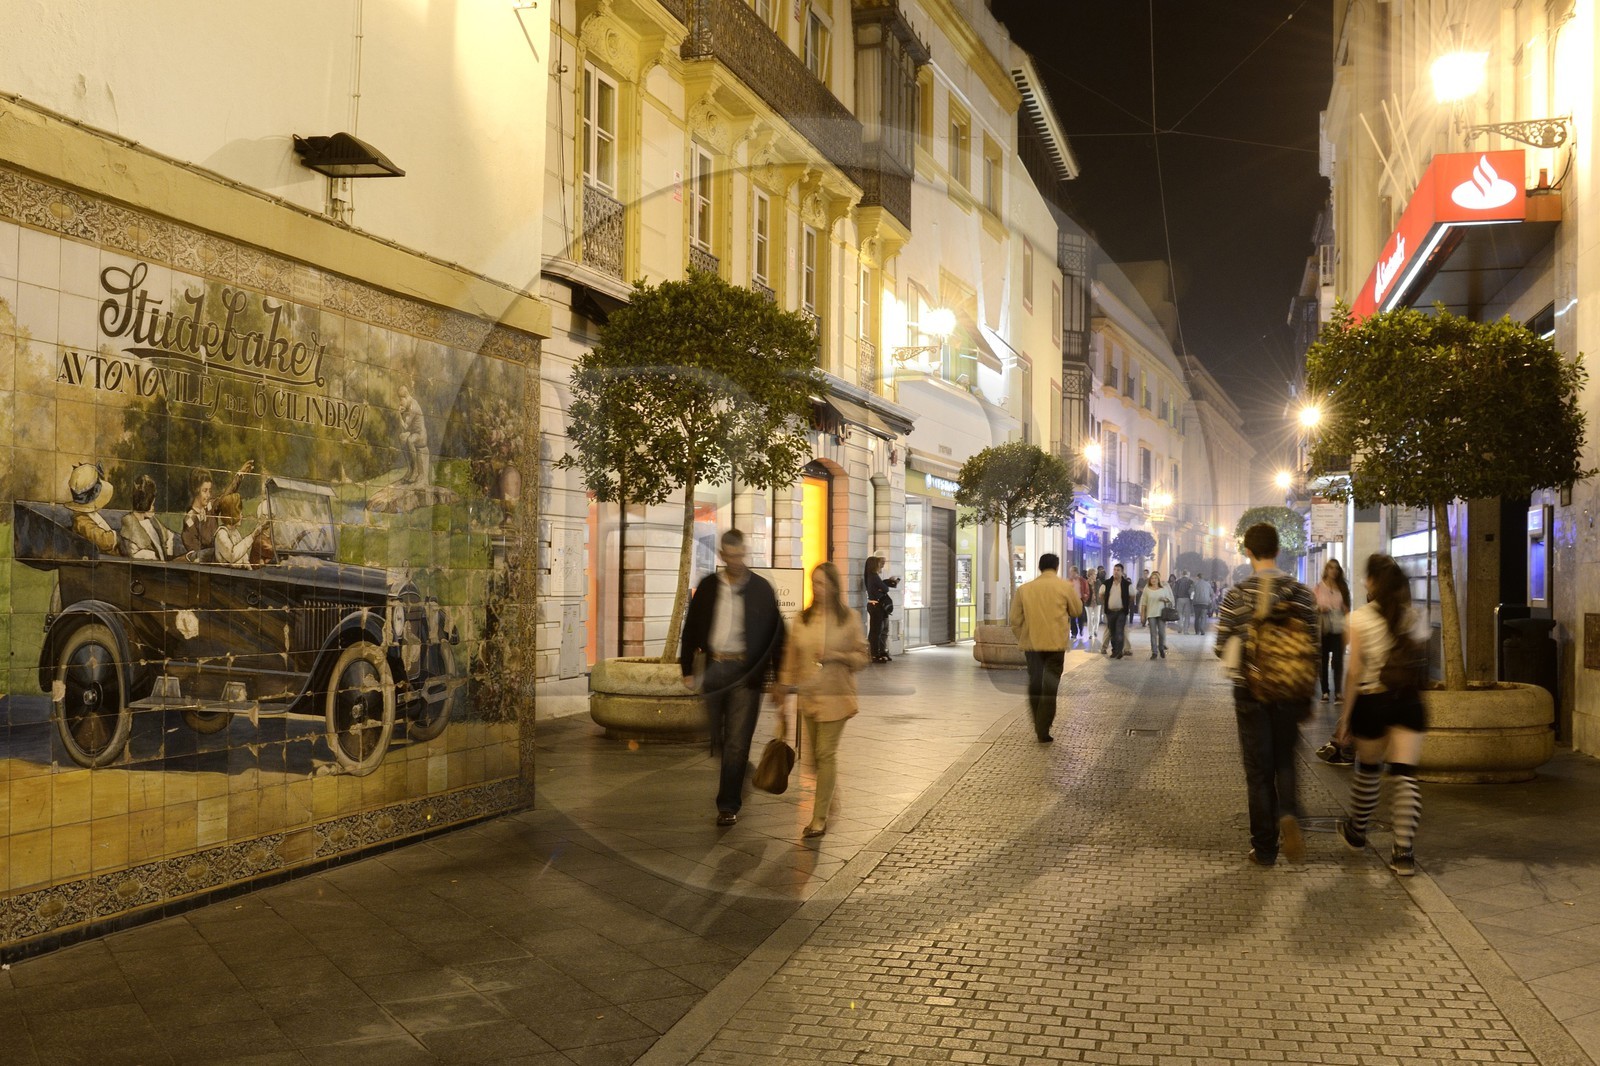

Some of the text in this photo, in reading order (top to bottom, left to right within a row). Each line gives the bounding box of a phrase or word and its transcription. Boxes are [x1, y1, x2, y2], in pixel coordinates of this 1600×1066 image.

[100, 262, 326, 387] Studebaker
[253, 380, 267, 418] 6
[272, 389, 368, 440] CILINDROS
